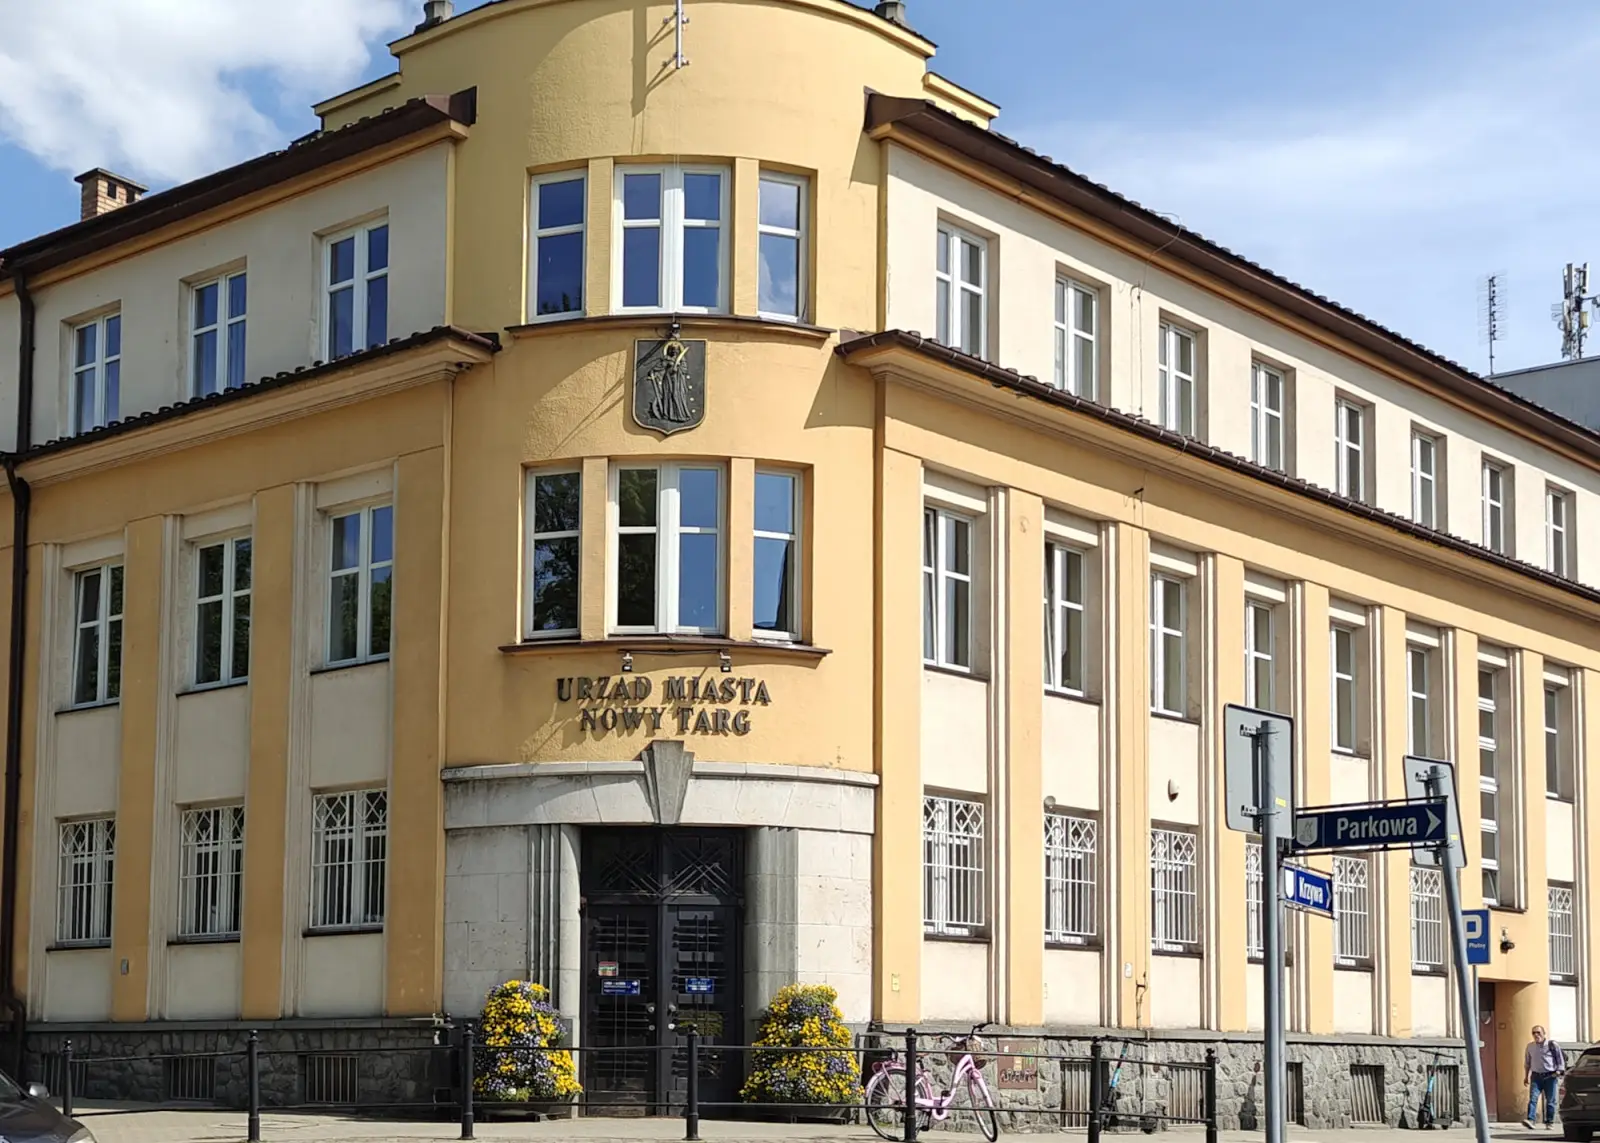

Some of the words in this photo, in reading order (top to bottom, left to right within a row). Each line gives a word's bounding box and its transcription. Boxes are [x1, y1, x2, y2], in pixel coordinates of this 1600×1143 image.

[667, 676, 772, 705] MIASTA
[580, 706, 667, 732] NOWY
[676, 705, 751, 735] TARG
[1336, 815, 1418, 840] Parkowa
[1298, 877, 1324, 905] Krzywa
[1462, 914, 1482, 939] P
